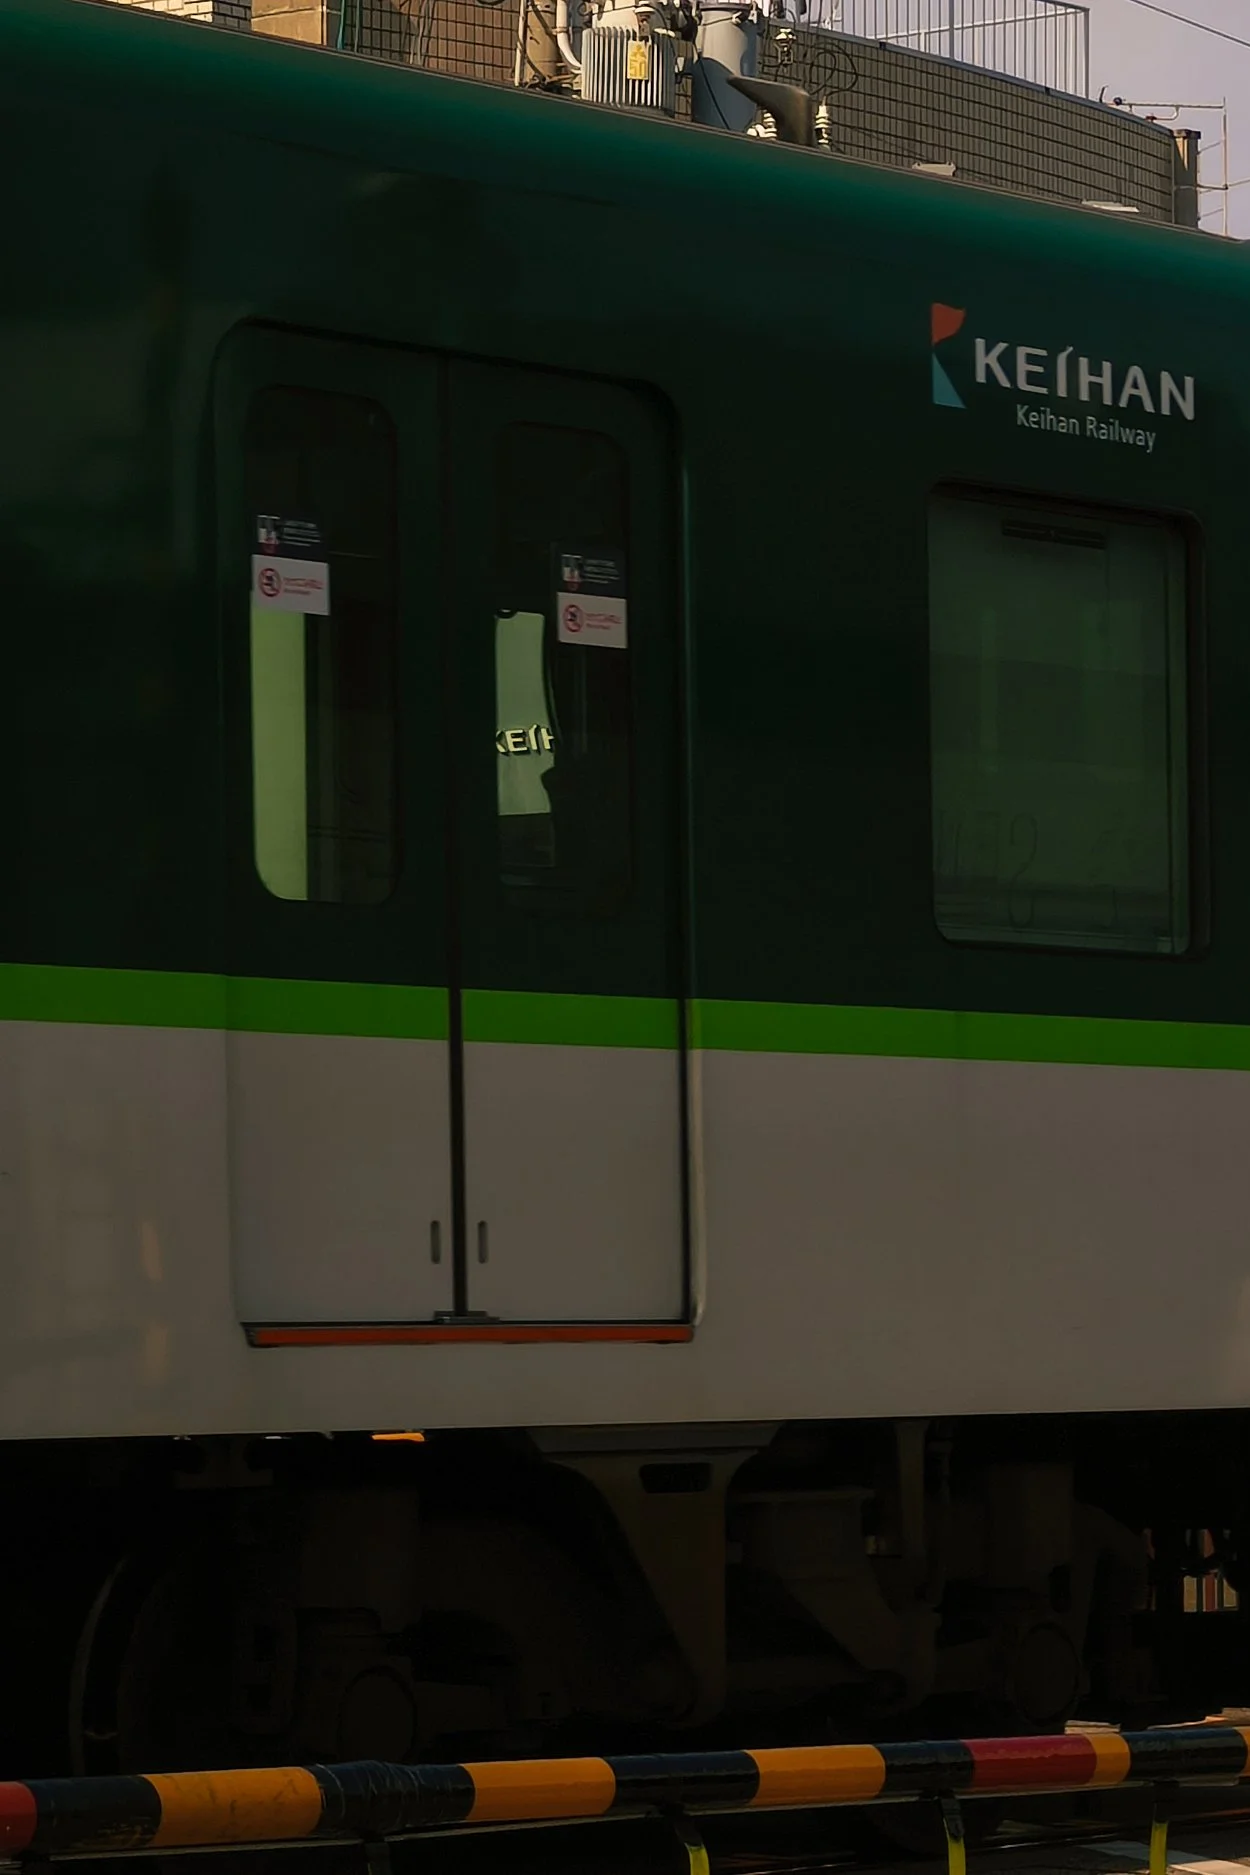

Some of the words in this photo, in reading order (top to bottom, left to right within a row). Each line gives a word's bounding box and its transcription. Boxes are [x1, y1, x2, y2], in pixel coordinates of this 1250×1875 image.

[974, 337, 1195, 421] KEIHAN
[1015, 403, 1080, 436] Keihan
[1086, 415, 1156, 454] Railway
